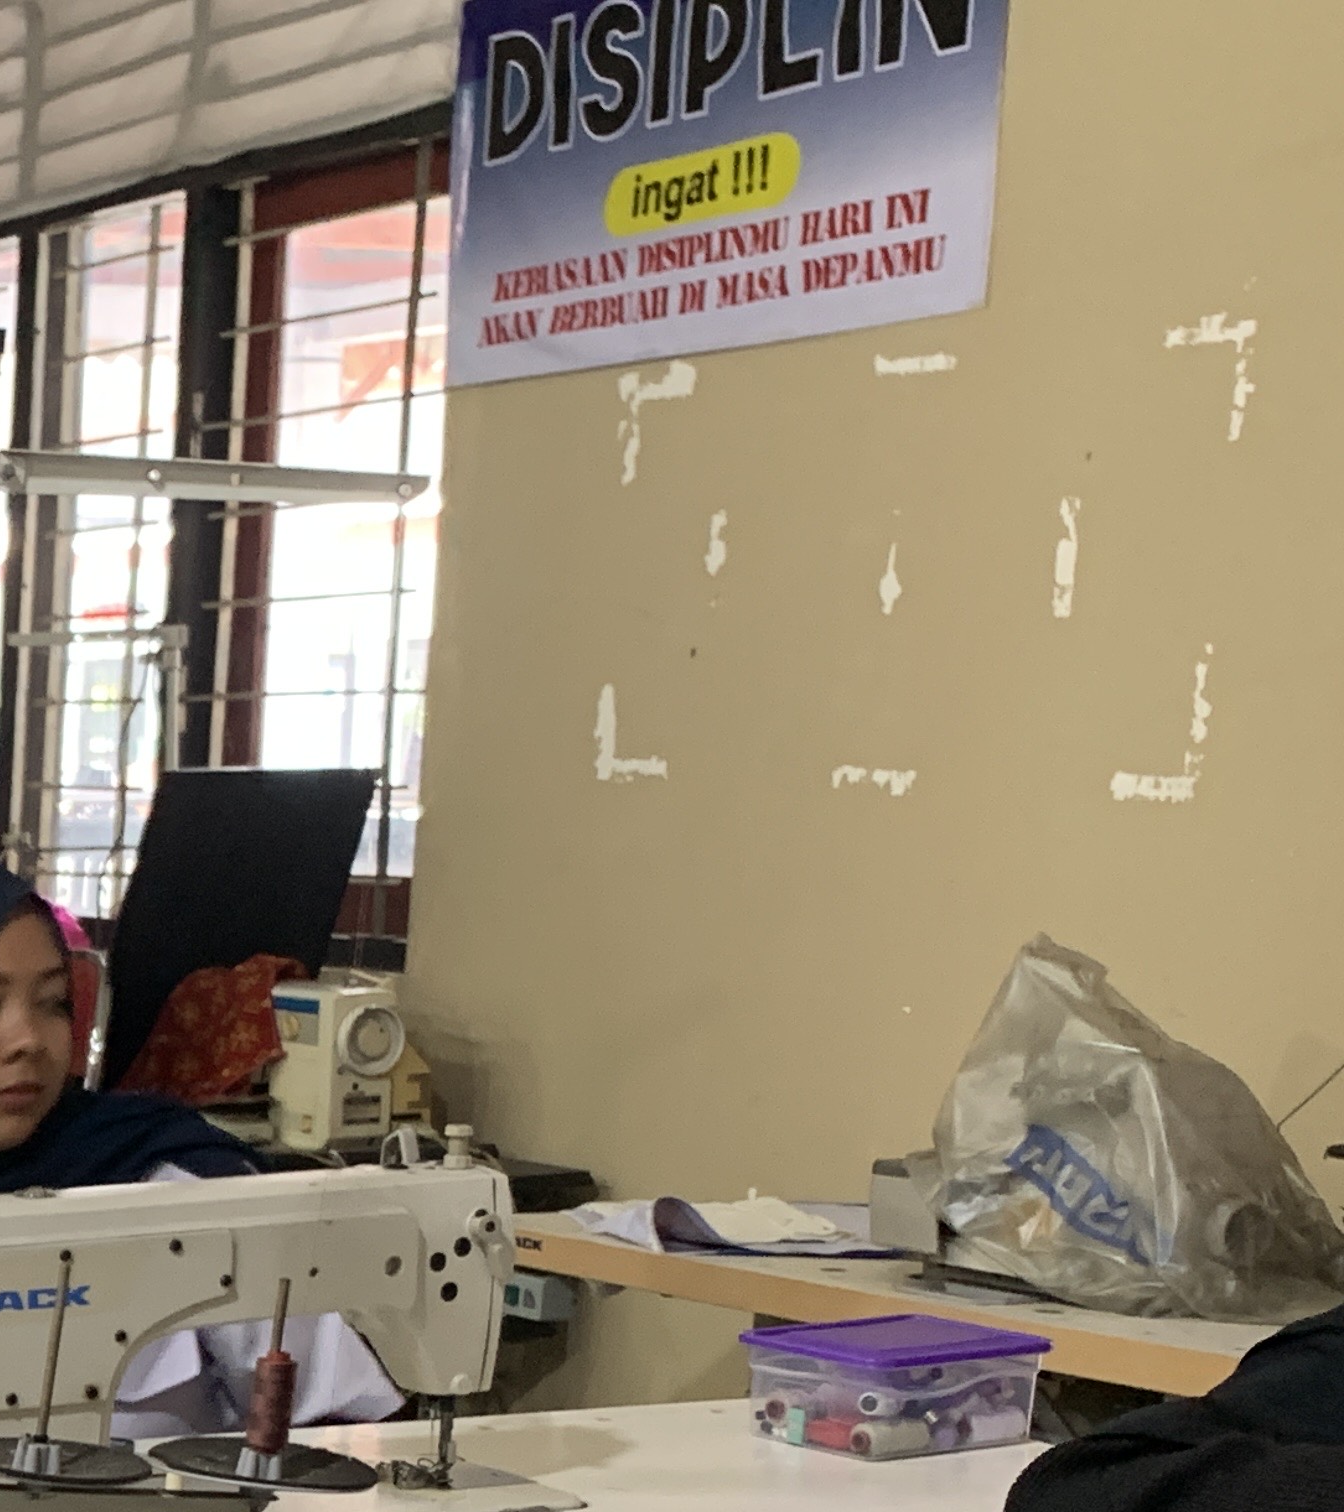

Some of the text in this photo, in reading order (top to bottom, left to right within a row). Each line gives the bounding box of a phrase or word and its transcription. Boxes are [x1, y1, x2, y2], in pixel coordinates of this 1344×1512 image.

[631, 145, 771, 222] ingat !!!
[477, 233, 947, 347] AKAN BERBUAH DI MASA DEPANMU
[493, 188, 930, 303] KEBIASAAN DISIPLINMU HARI INI
[514, 1236, 543, 1252] ACK
